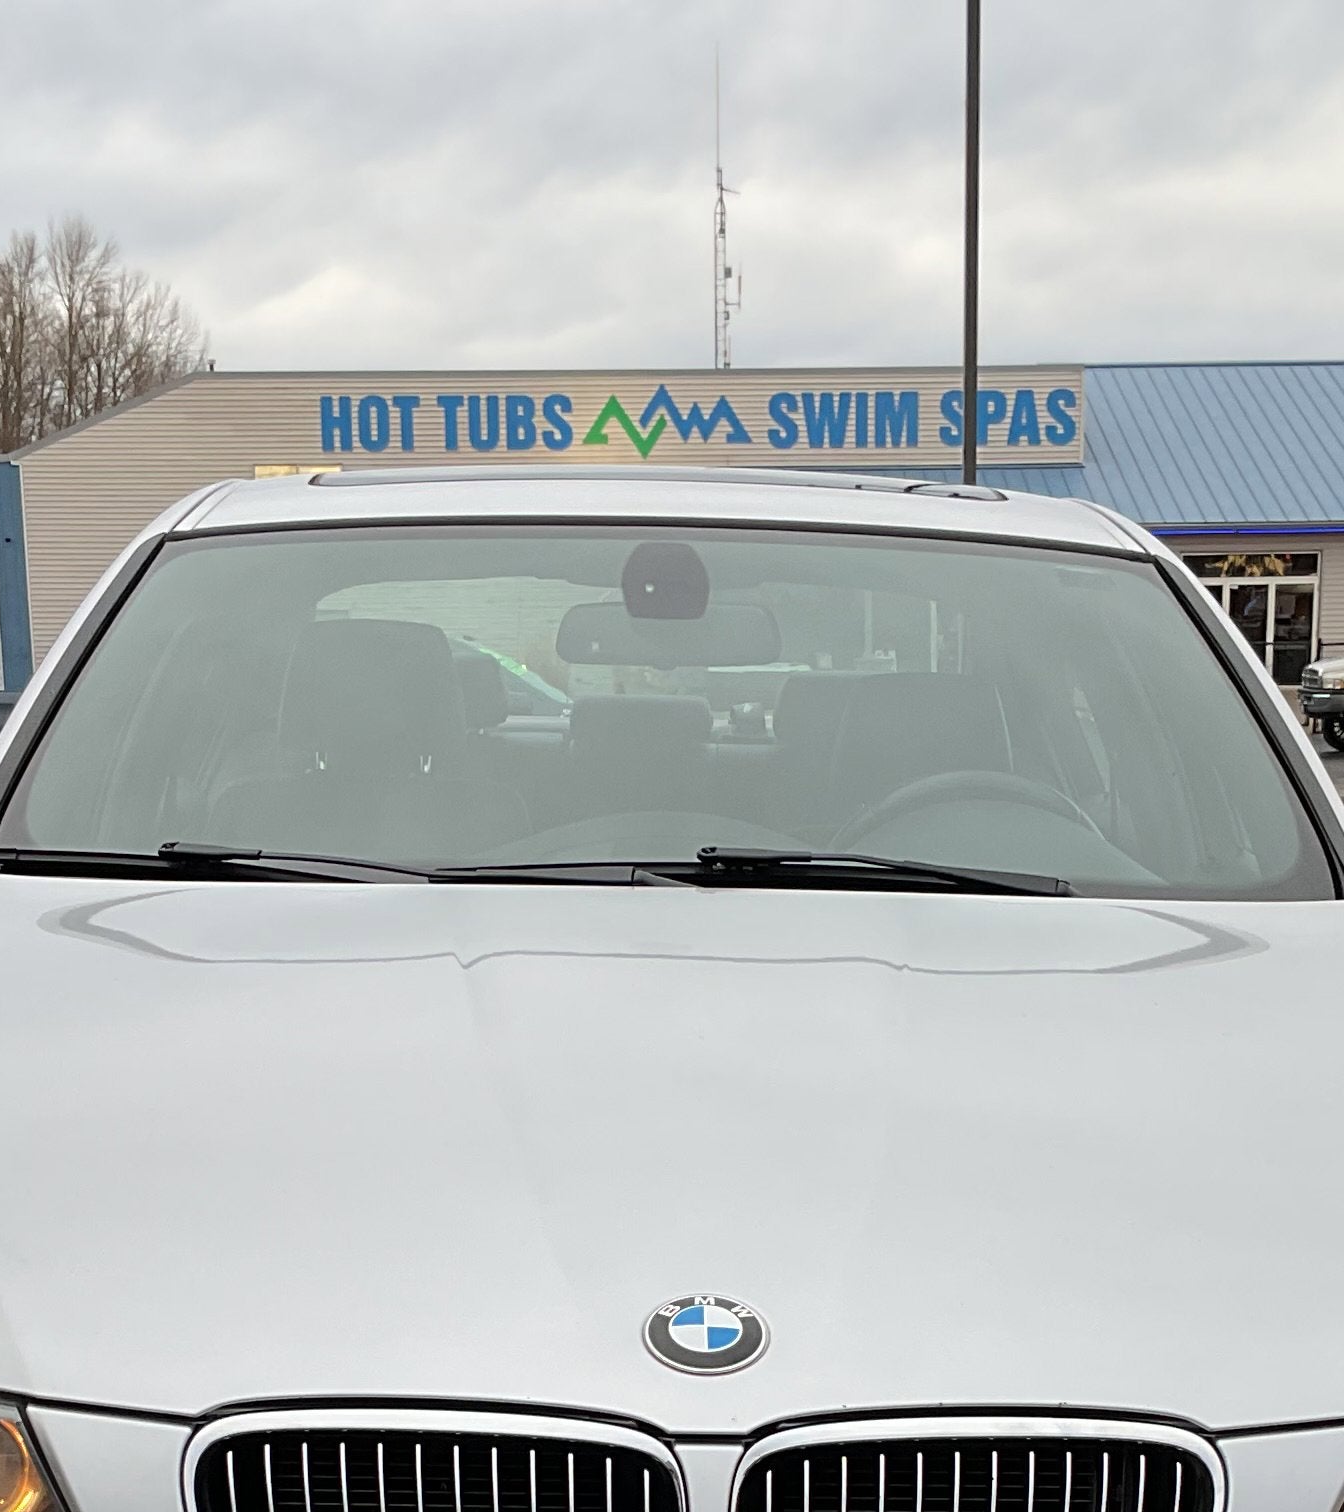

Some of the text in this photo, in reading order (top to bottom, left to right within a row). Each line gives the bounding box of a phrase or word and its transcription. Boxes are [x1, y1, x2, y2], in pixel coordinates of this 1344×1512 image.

[320, 394, 574, 452] HOT TUBS
[767, 388, 1077, 449] SWIM SPAS
[657, 1296, 754, 1318] BMW
